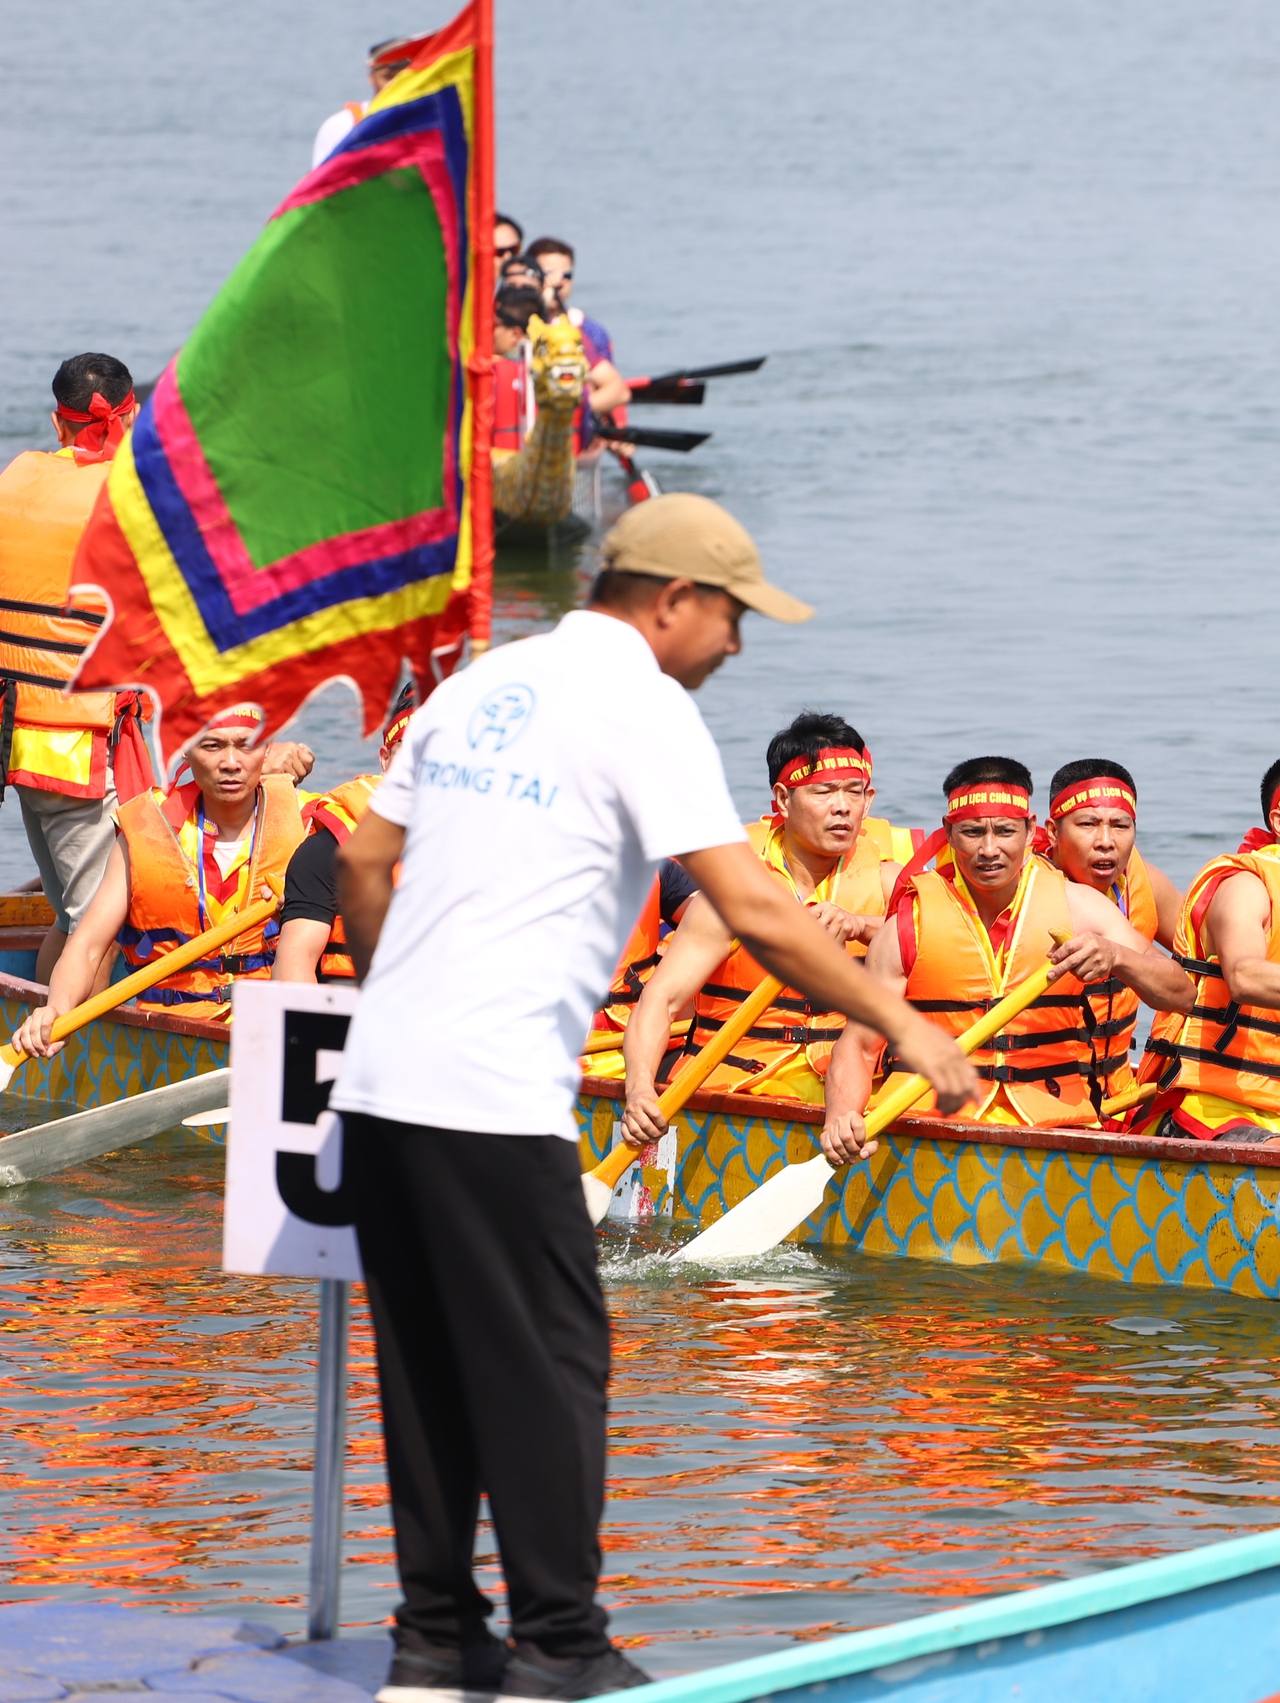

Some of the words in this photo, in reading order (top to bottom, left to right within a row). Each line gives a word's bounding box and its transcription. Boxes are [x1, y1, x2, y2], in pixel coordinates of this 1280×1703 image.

[969, 792, 988, 805] LỊCH
[989, 791, 1012, 804] CHÙA
[1088, 787, 1101, 799] DU
[275, 1009, 357, 1228] 5
